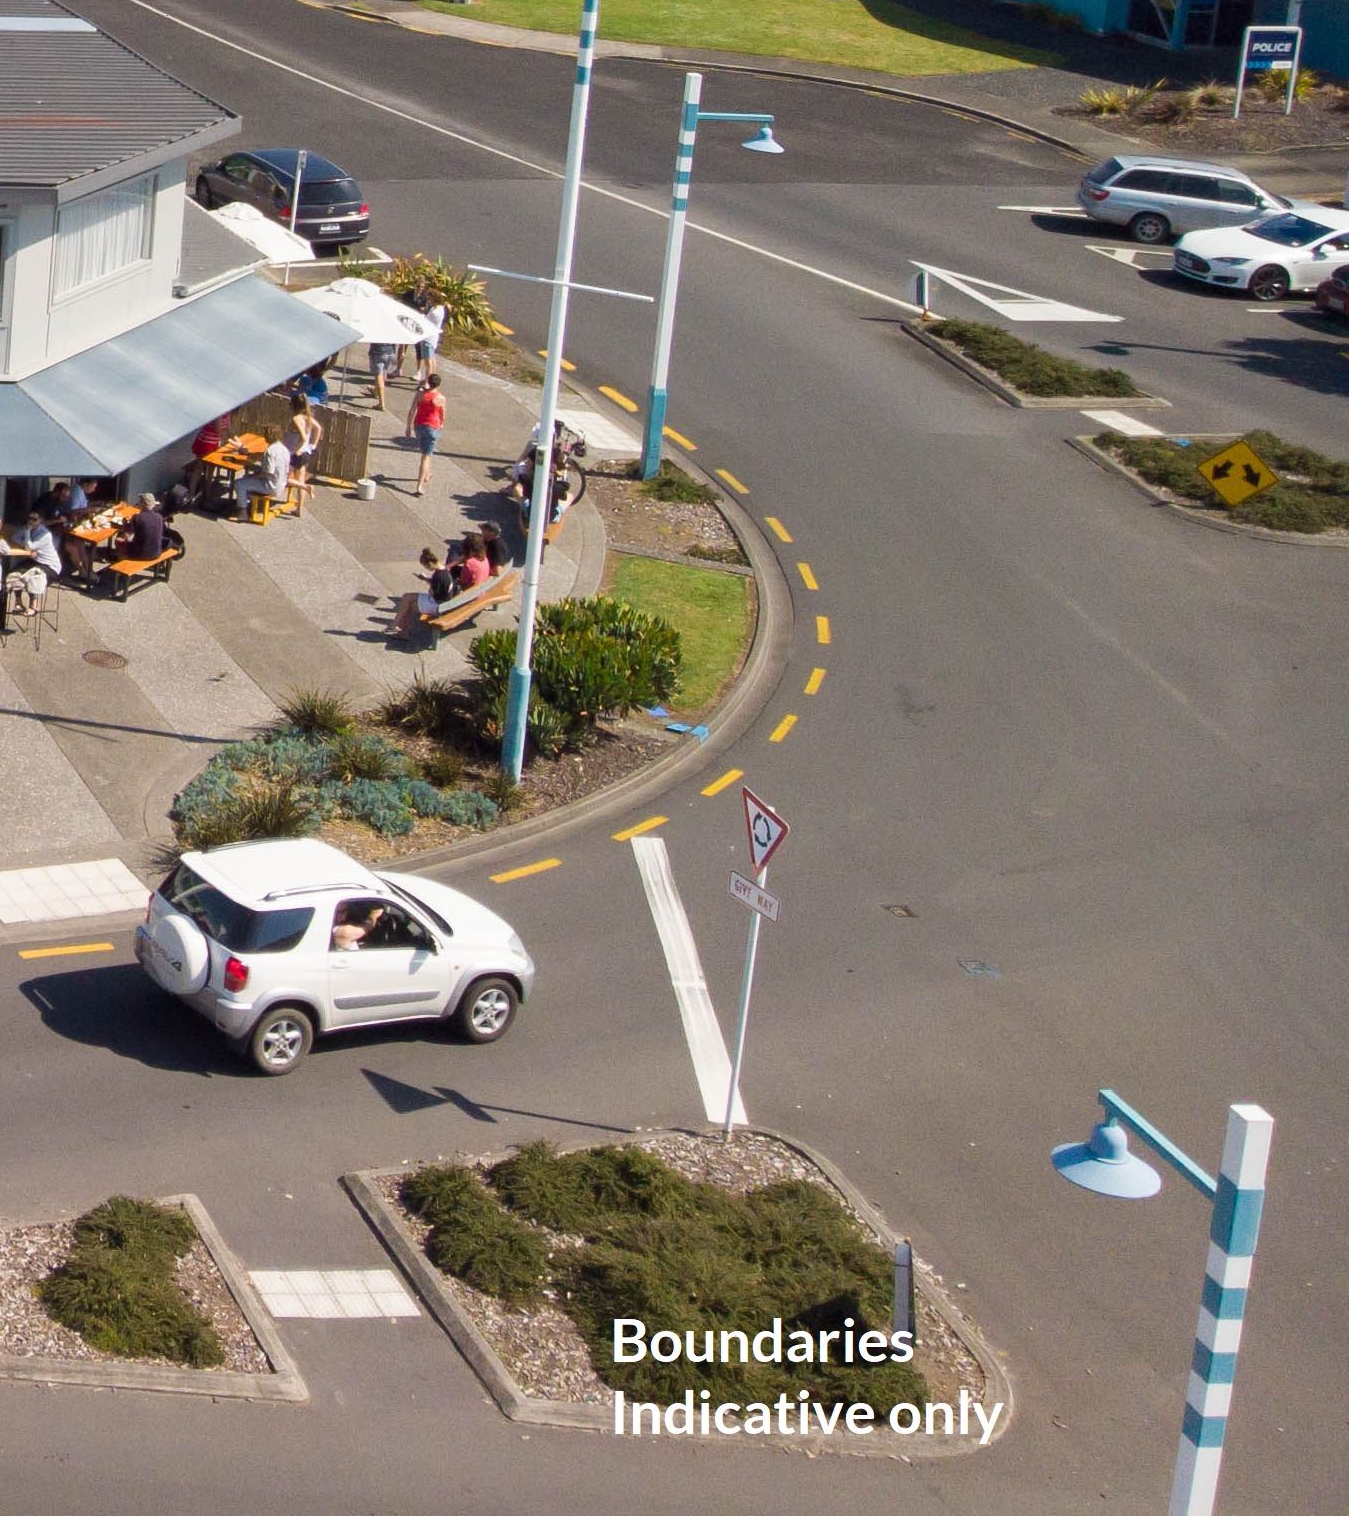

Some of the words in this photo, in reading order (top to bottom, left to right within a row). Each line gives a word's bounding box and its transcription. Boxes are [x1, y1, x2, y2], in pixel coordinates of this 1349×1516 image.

[1252, 43, 1292, 52] POLICE
[735, 880, 750, 897] GIVE
[758, 895, 772, 911] WAY
